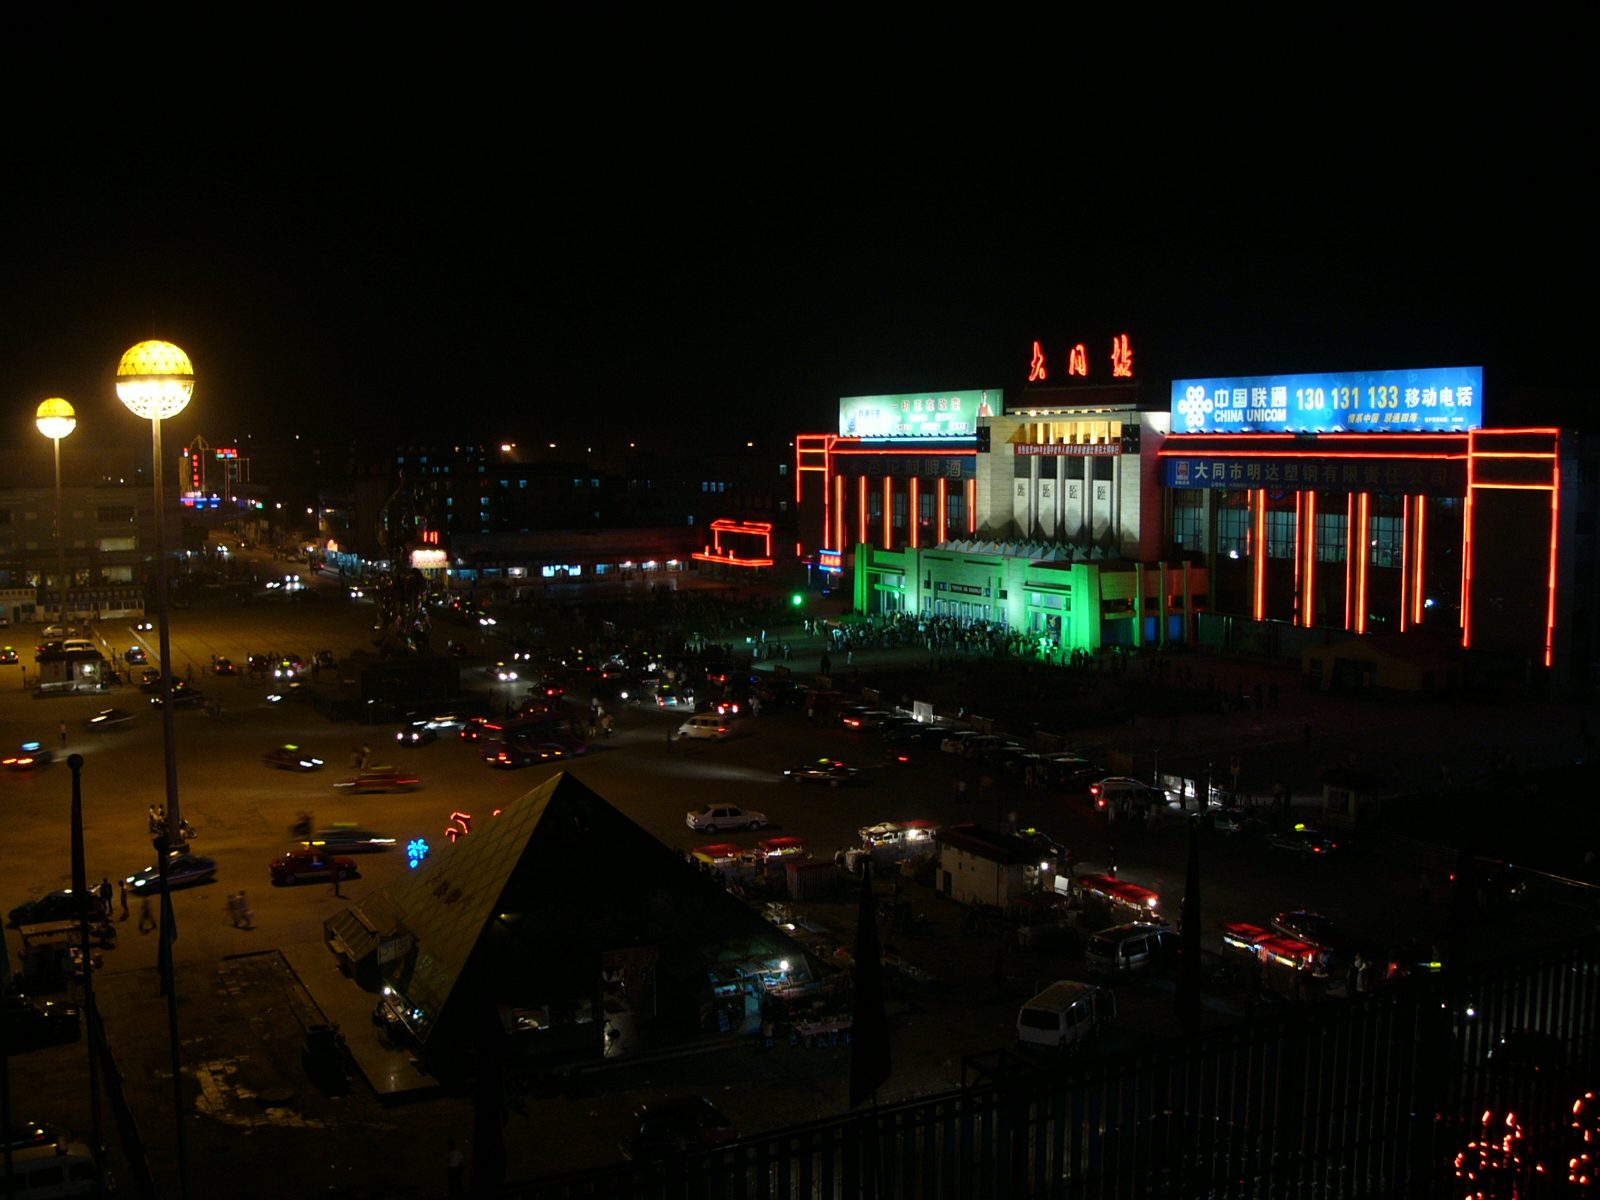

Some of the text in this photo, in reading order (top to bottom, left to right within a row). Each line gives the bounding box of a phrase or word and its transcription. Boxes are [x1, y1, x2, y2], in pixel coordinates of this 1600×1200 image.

[1028, 333, 1134, 382] 大同站
[1214, 386, 1288, 409] 中国联通
[1296, 385, 1474, 411] 130 131 133 移动电话
[1213, 408, 1287, 423] CHINA UNICOM
